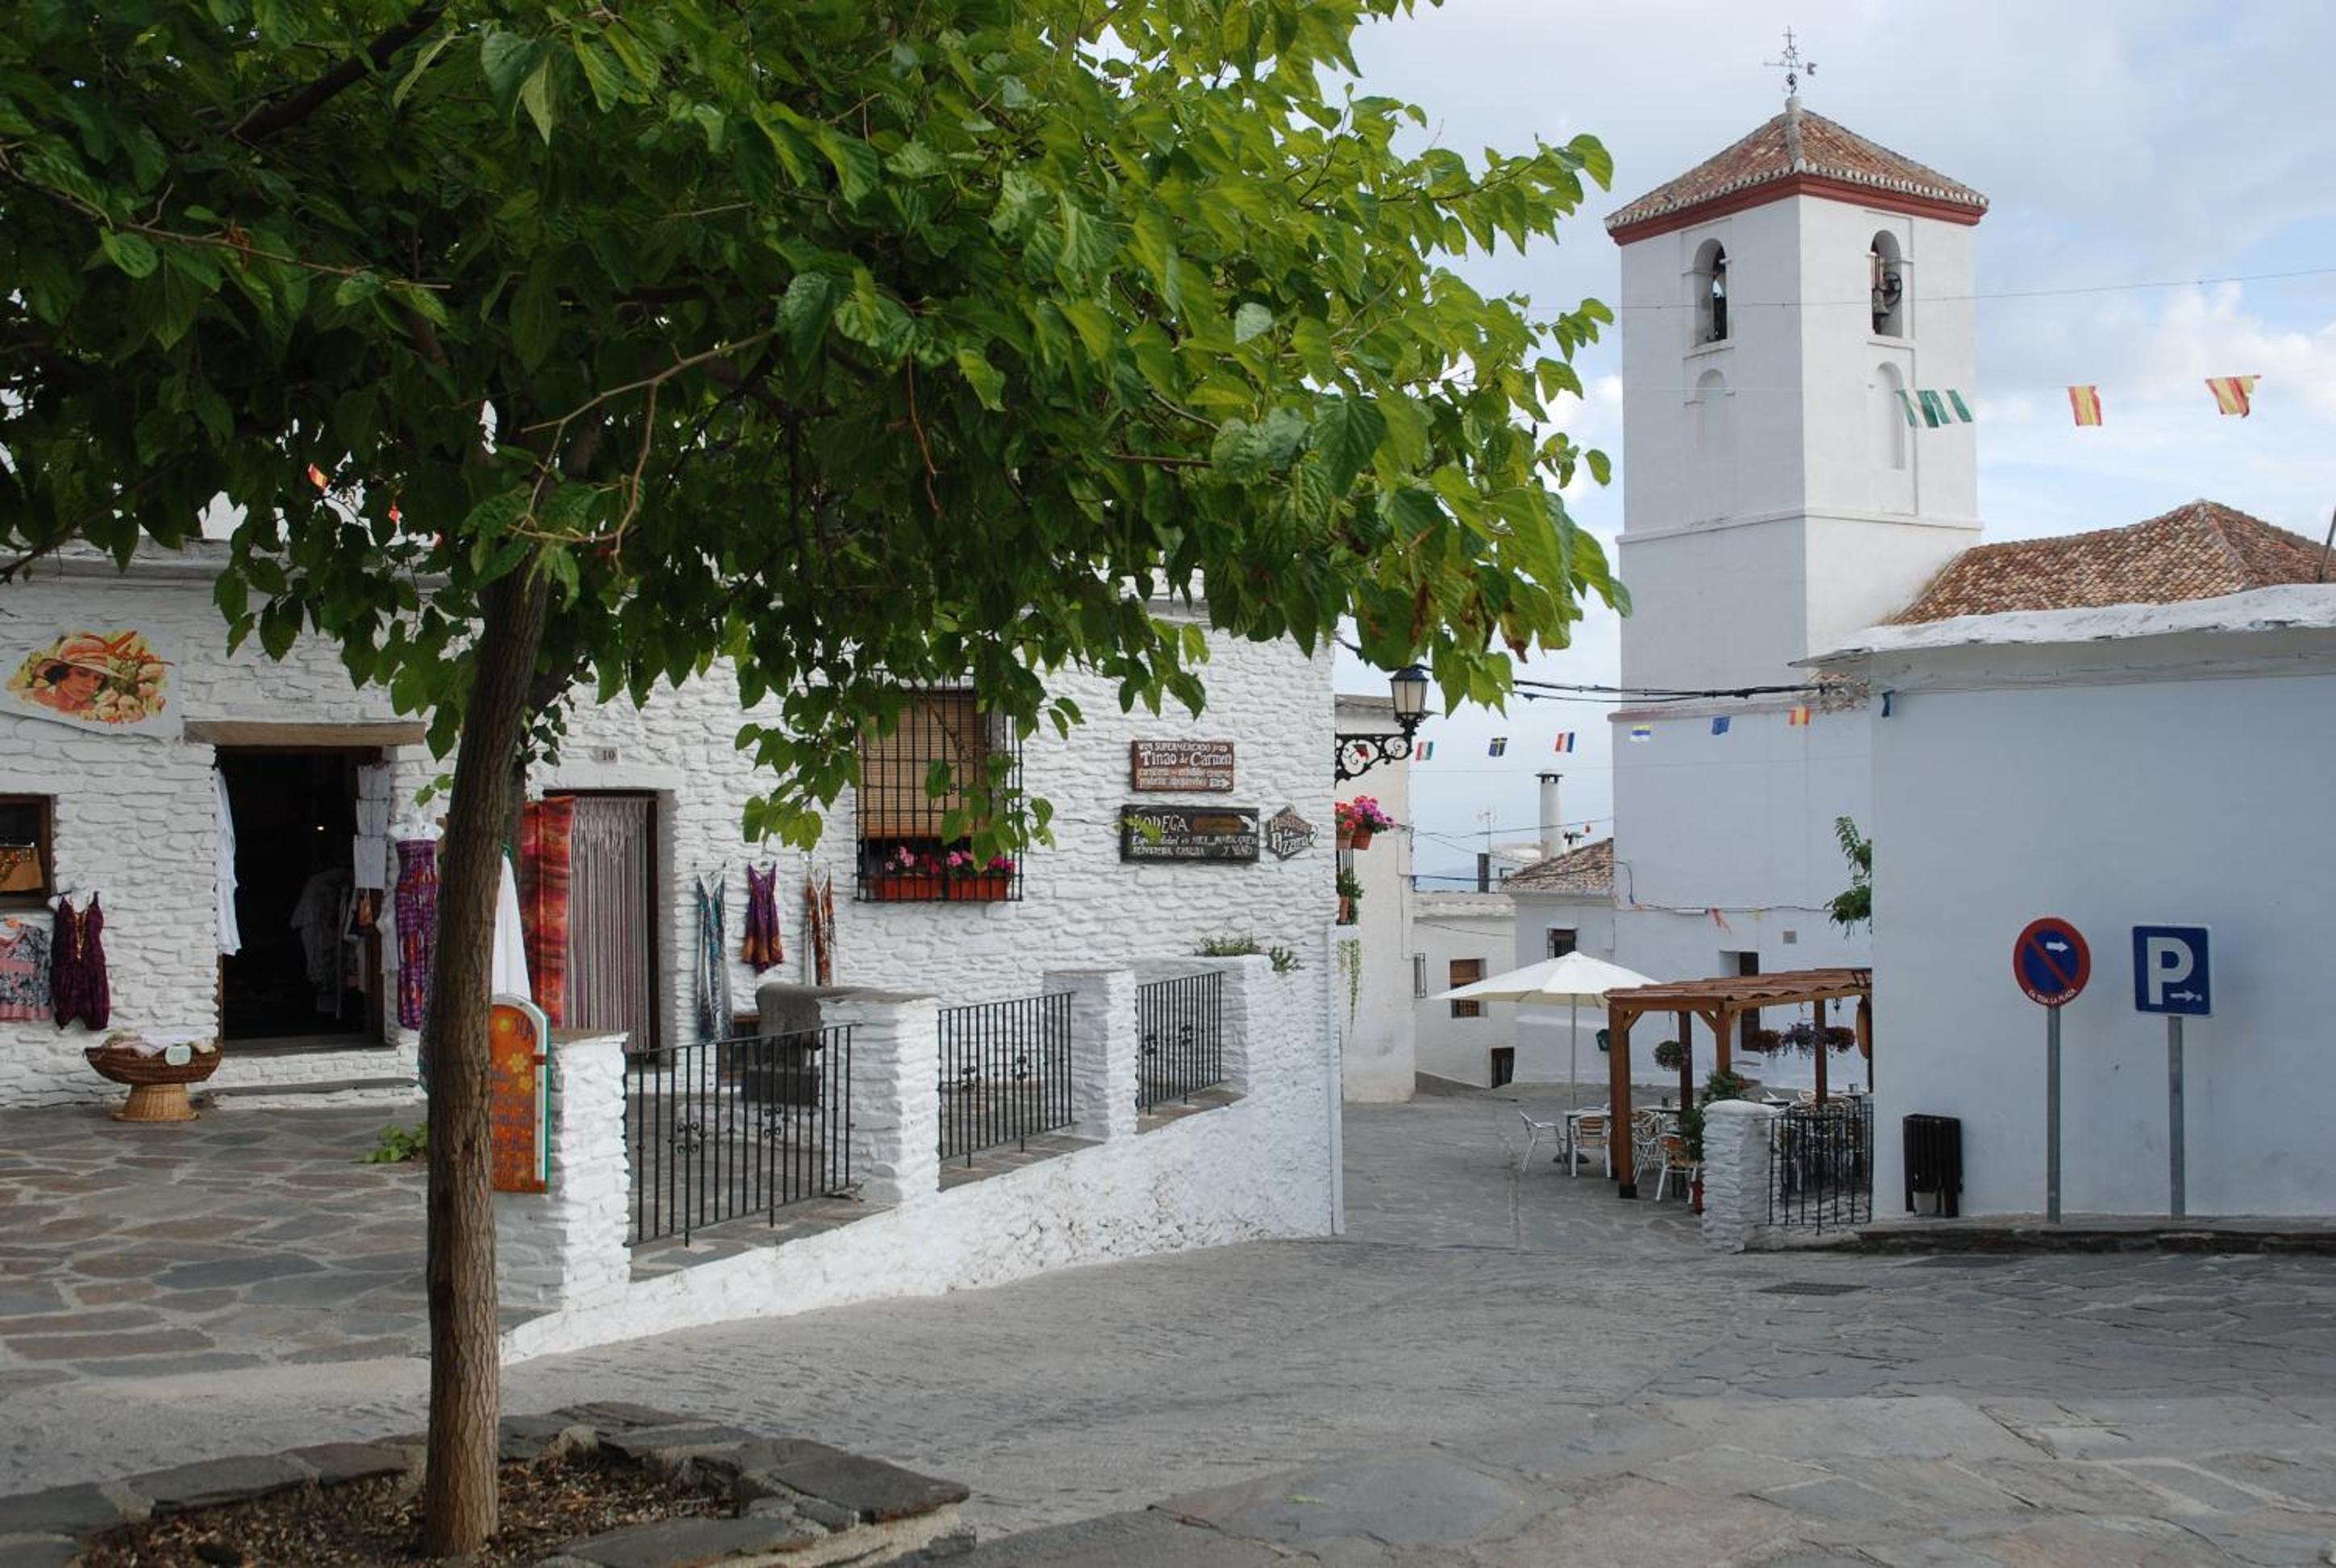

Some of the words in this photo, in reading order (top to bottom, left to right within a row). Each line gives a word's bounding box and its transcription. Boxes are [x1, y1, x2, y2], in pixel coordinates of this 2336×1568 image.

[603, 749, 615, 761] 10
[1139, 751, 1177, 766] Tinao
[1189, 752, 1233, 766] Carmen
[2147, 936, 2193, 1005] P
